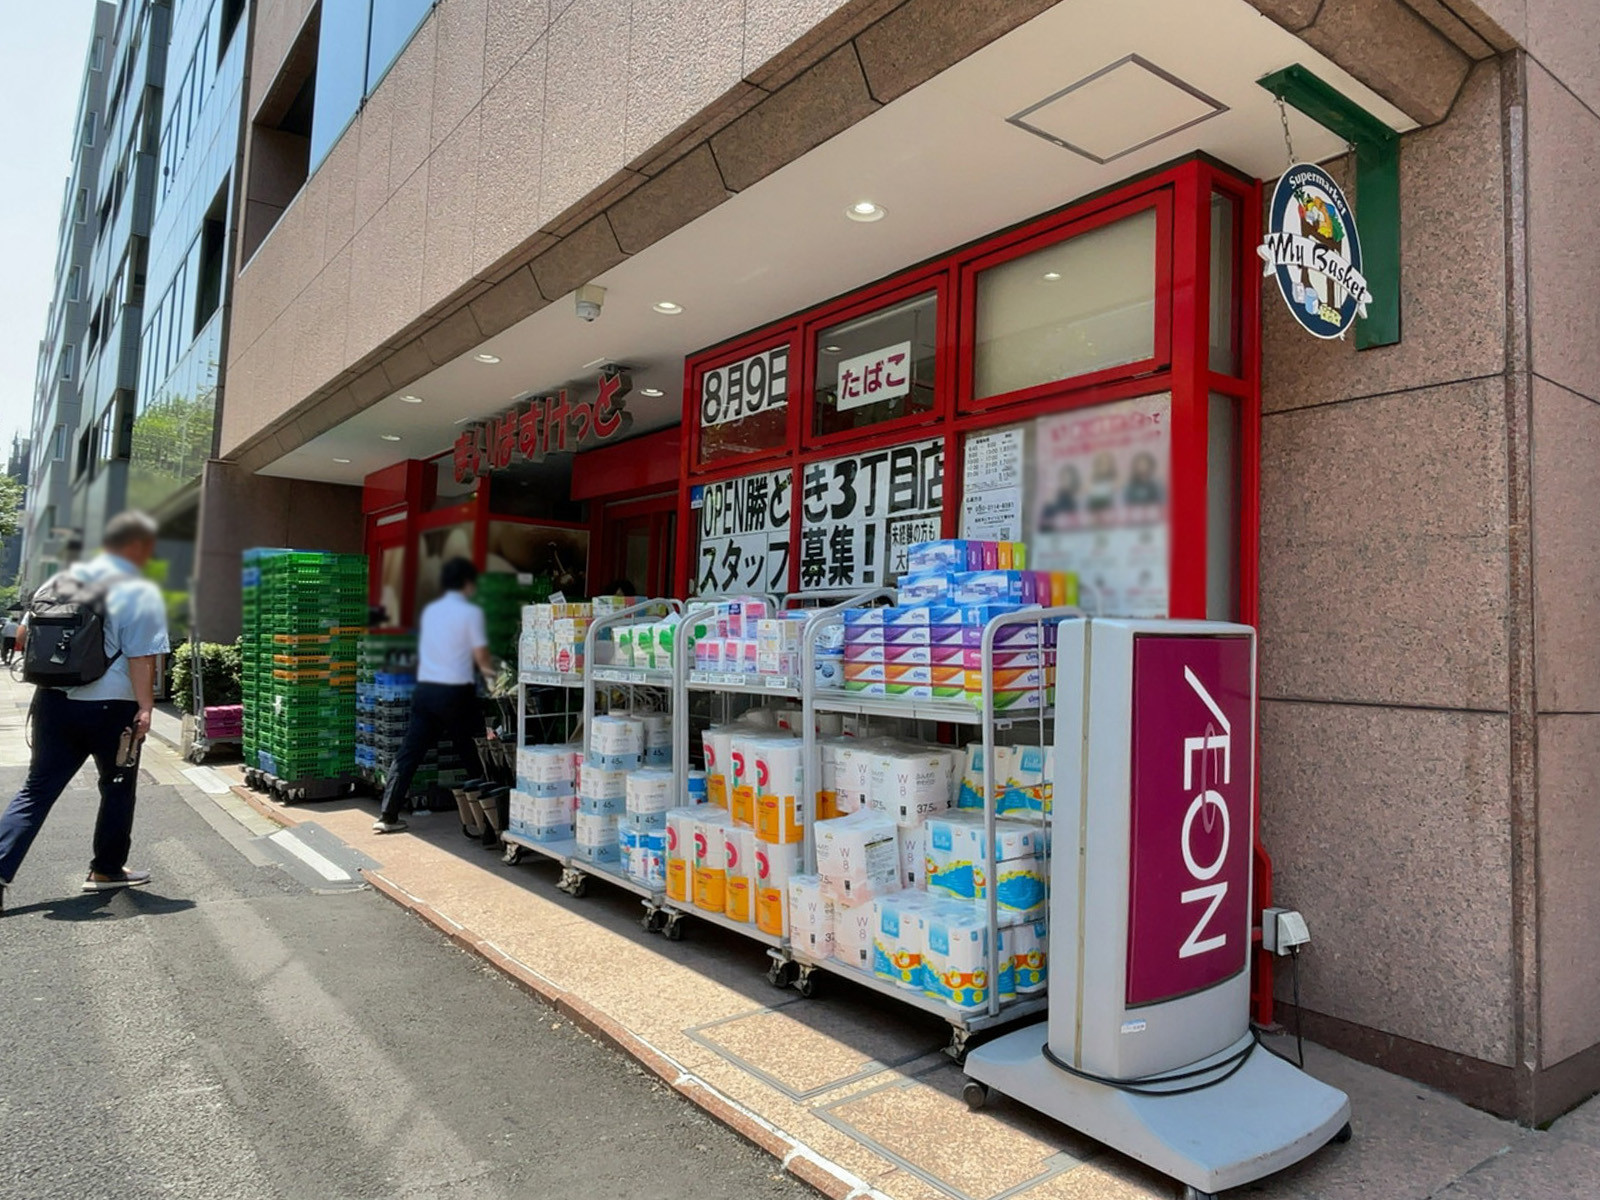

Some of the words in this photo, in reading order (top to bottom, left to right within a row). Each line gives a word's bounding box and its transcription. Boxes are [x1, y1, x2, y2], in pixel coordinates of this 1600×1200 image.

[1288, 172, 1347, 215] Supermarket
[1268, 233, 1304, 269] My
[1312, 243, 1366, 301] Basket
[702, 348, 789, 424] 8月9日
[841, 353, 905, 399] たばこ
